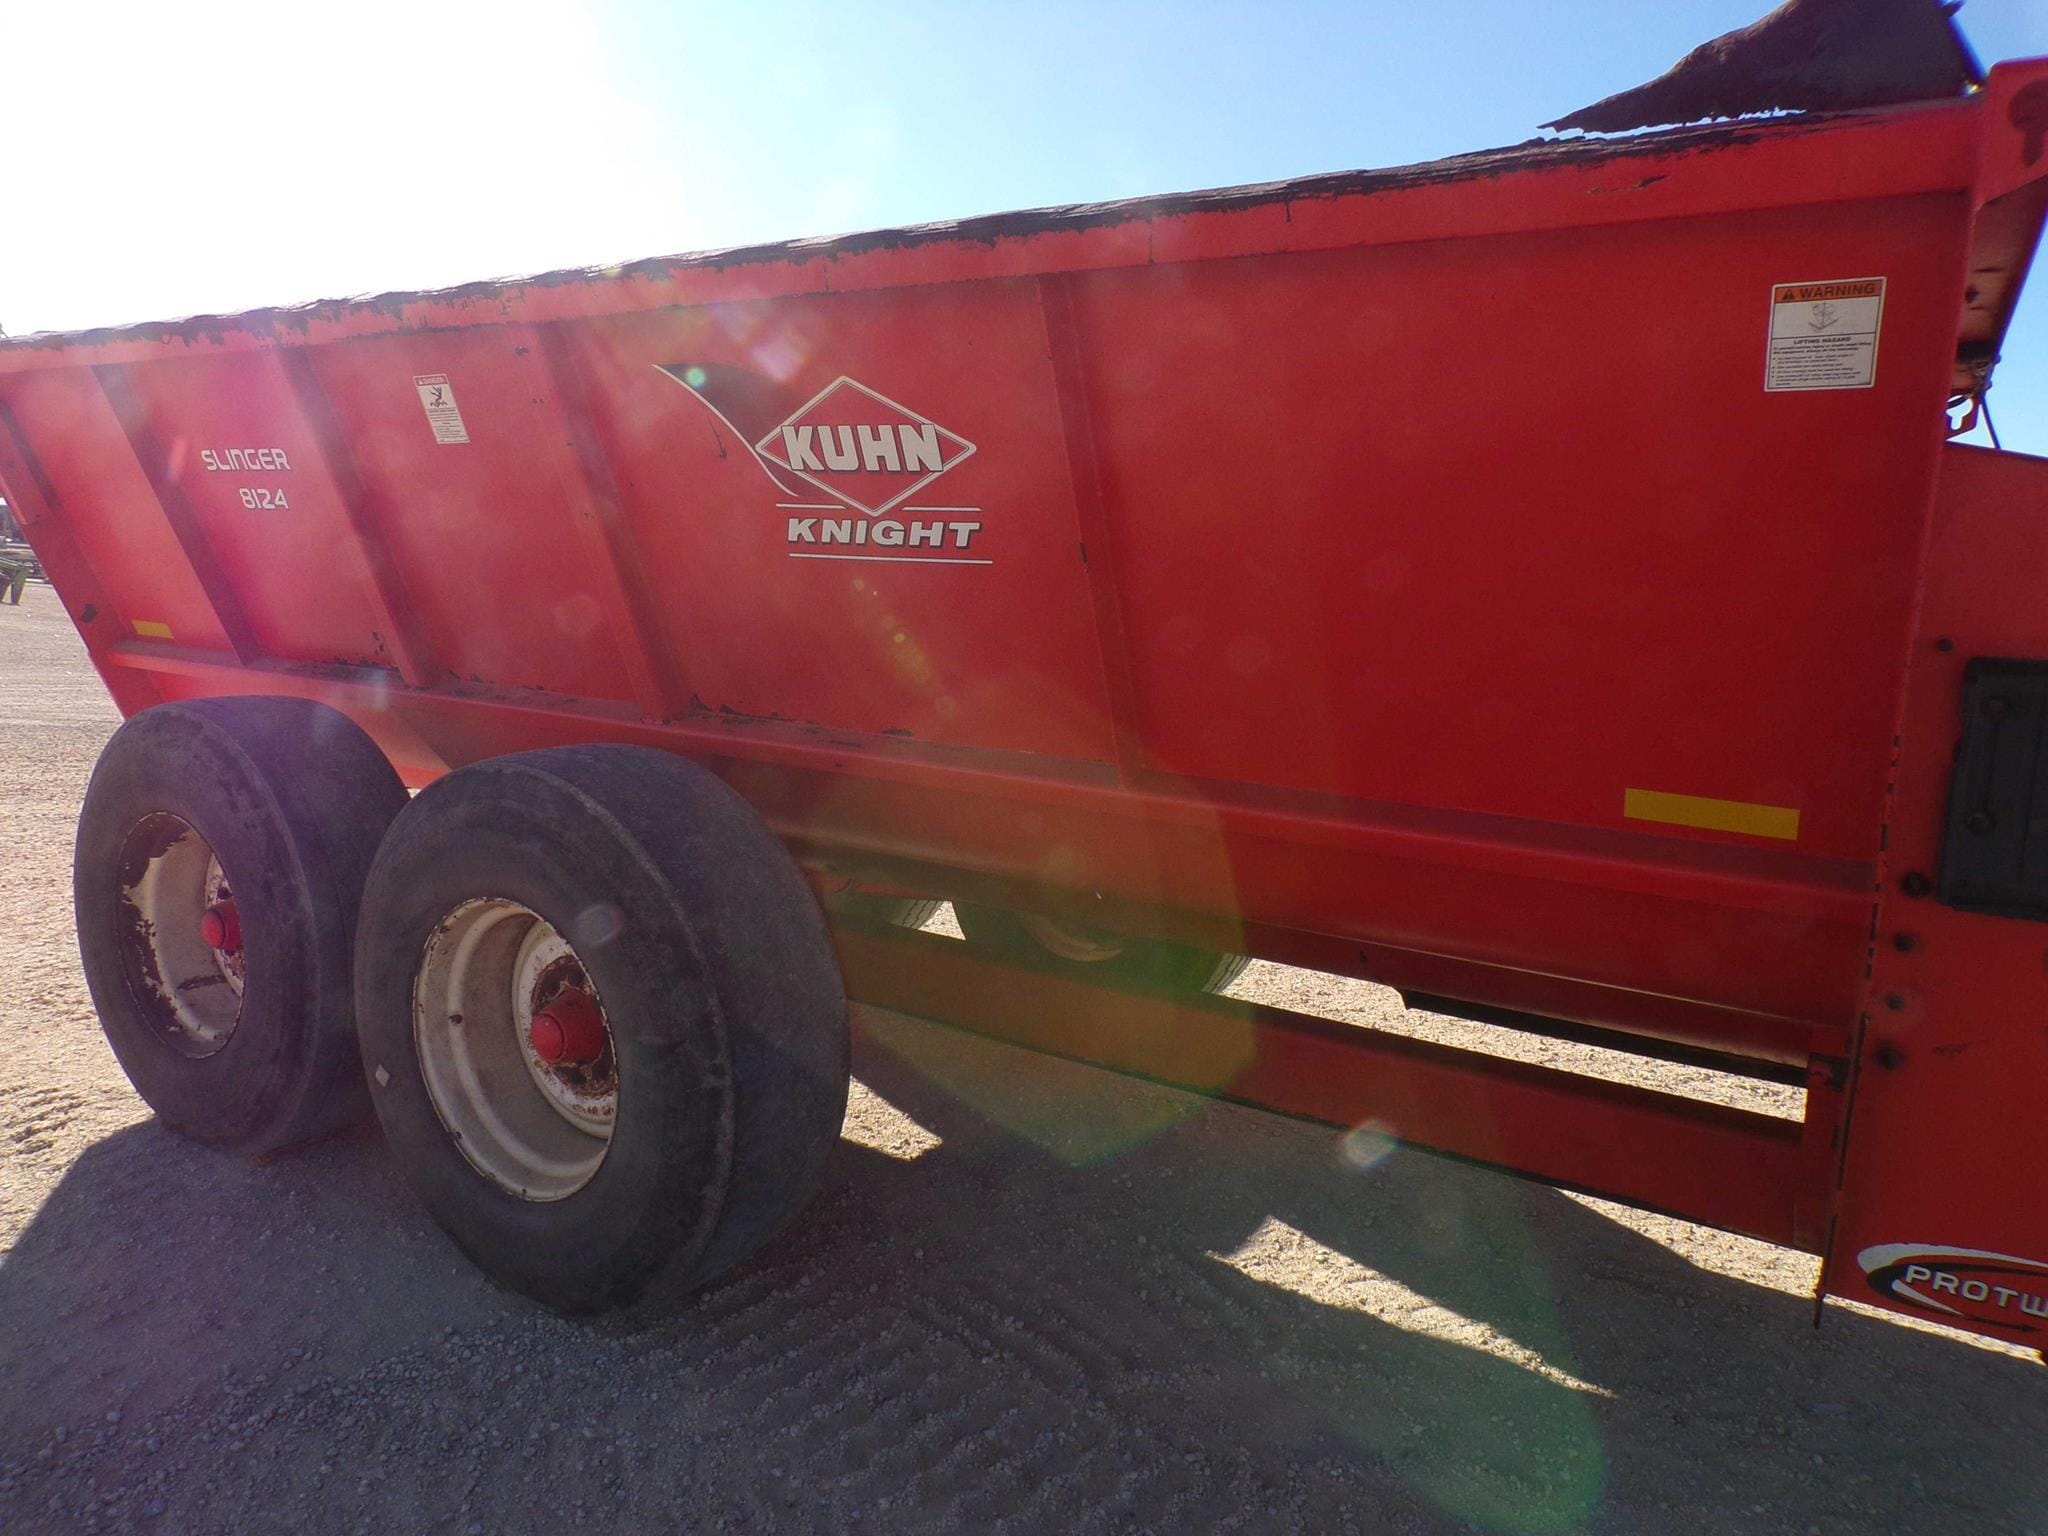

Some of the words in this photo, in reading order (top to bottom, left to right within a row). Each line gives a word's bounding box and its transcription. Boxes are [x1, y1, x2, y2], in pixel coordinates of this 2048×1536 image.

[1799, 284, 1874, 298] WARNING
[201, 448, 291, 471] SLINGER
[781, 424, 944, 472] KUHN
[239, 488, 288, 509] 8124
[787, 518, 981, 548] KNIGHT
